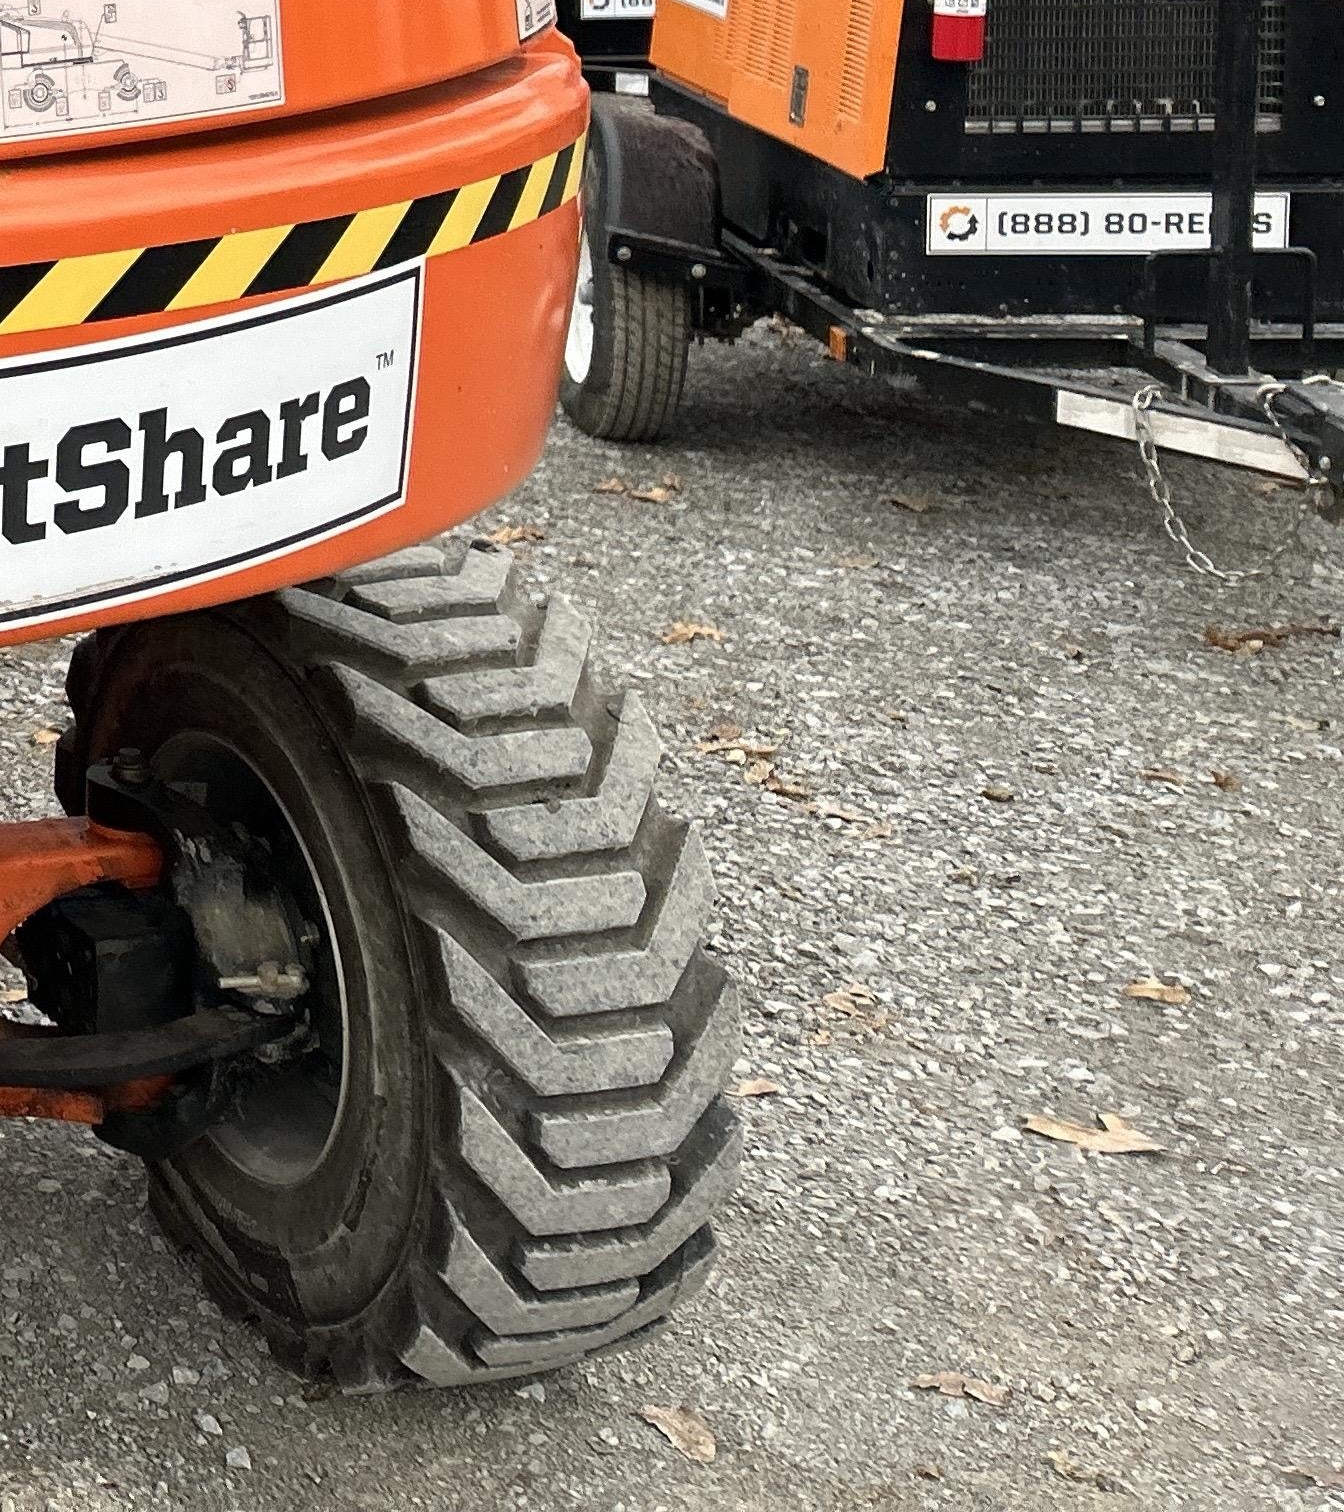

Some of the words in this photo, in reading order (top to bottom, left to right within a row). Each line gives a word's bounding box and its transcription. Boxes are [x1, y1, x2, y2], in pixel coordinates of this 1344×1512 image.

[998, 211, 1090, 237] (888)
[1103, 212, 1273, 235] 80-RES
[375, 348, 395, 371] TM
